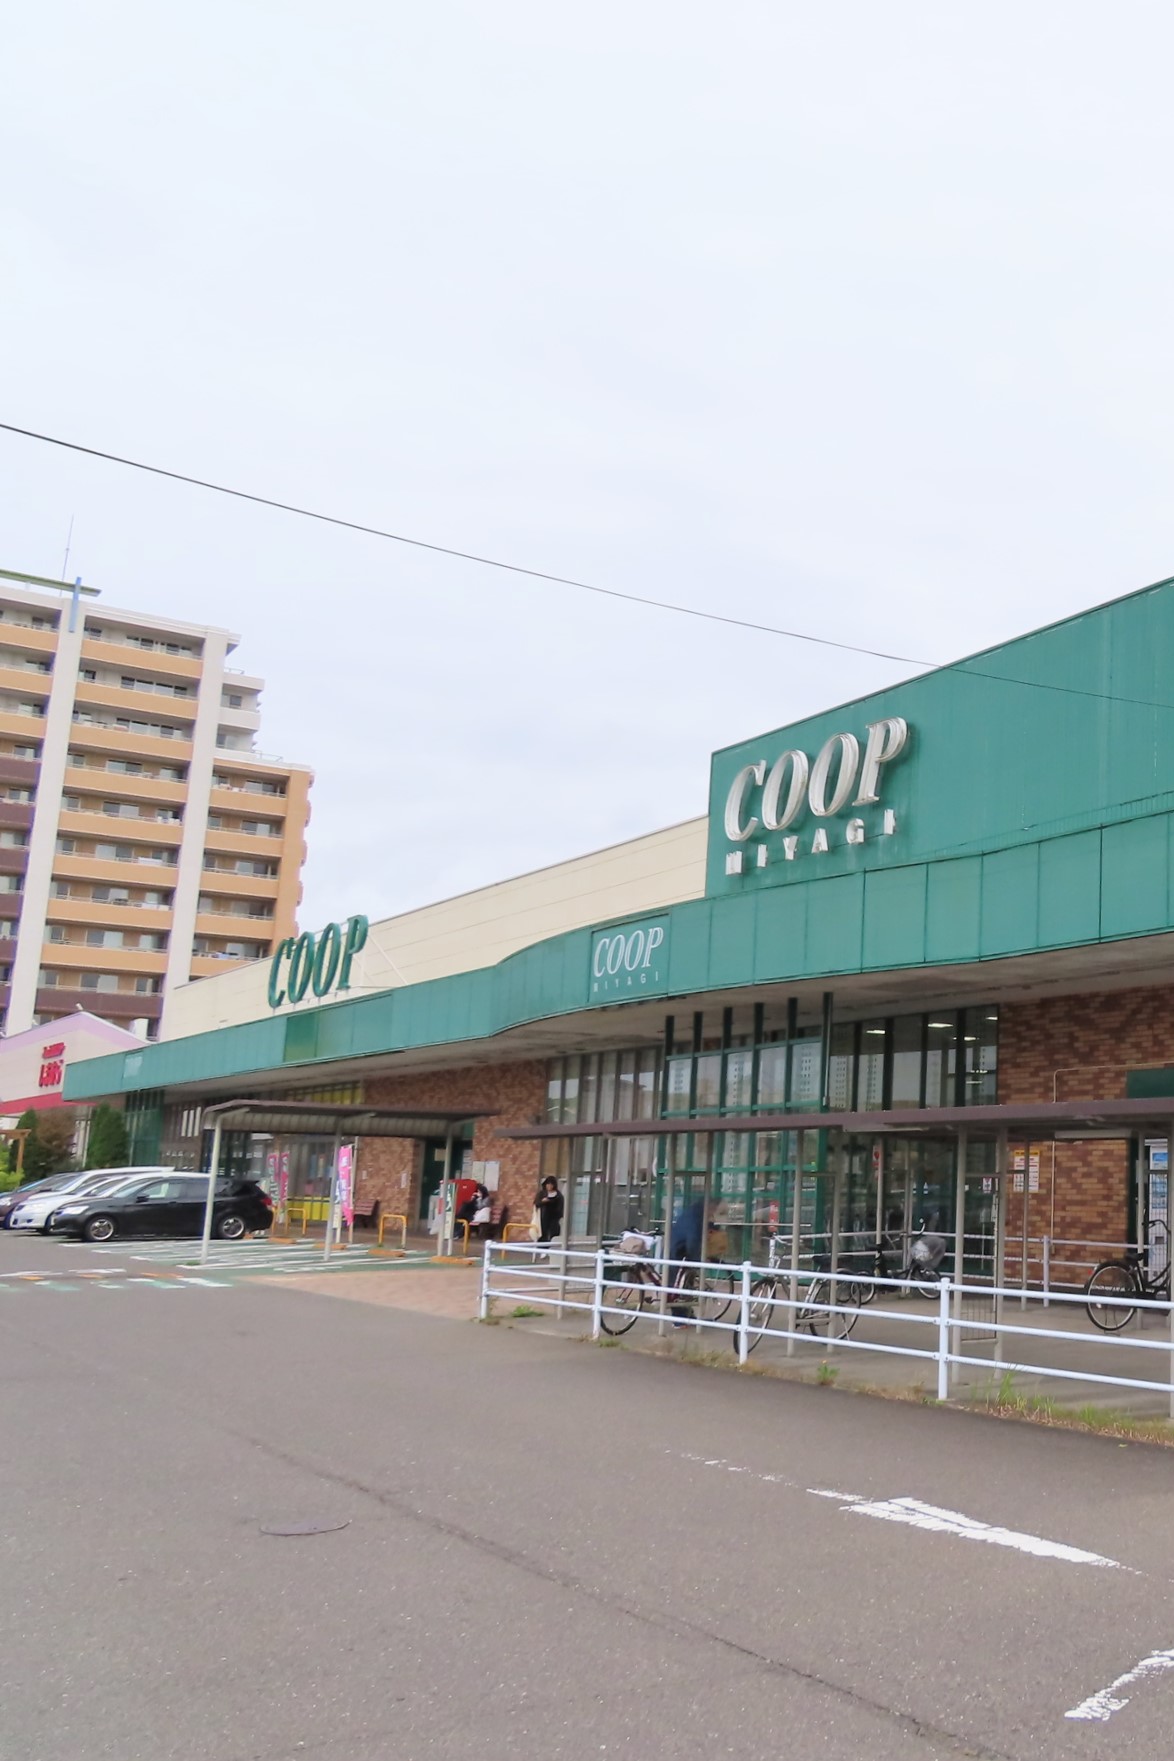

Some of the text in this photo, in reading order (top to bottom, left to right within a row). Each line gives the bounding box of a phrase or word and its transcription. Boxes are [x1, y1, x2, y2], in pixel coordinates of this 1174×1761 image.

[724, 717, 907, 842] COOP
[725, 809, 896, 875] MIYAGI
[268, 914, 369, 1009] COOP
[593, 926, 664, 977] COOP
[593, 971, 660, 992] MIYAGI
